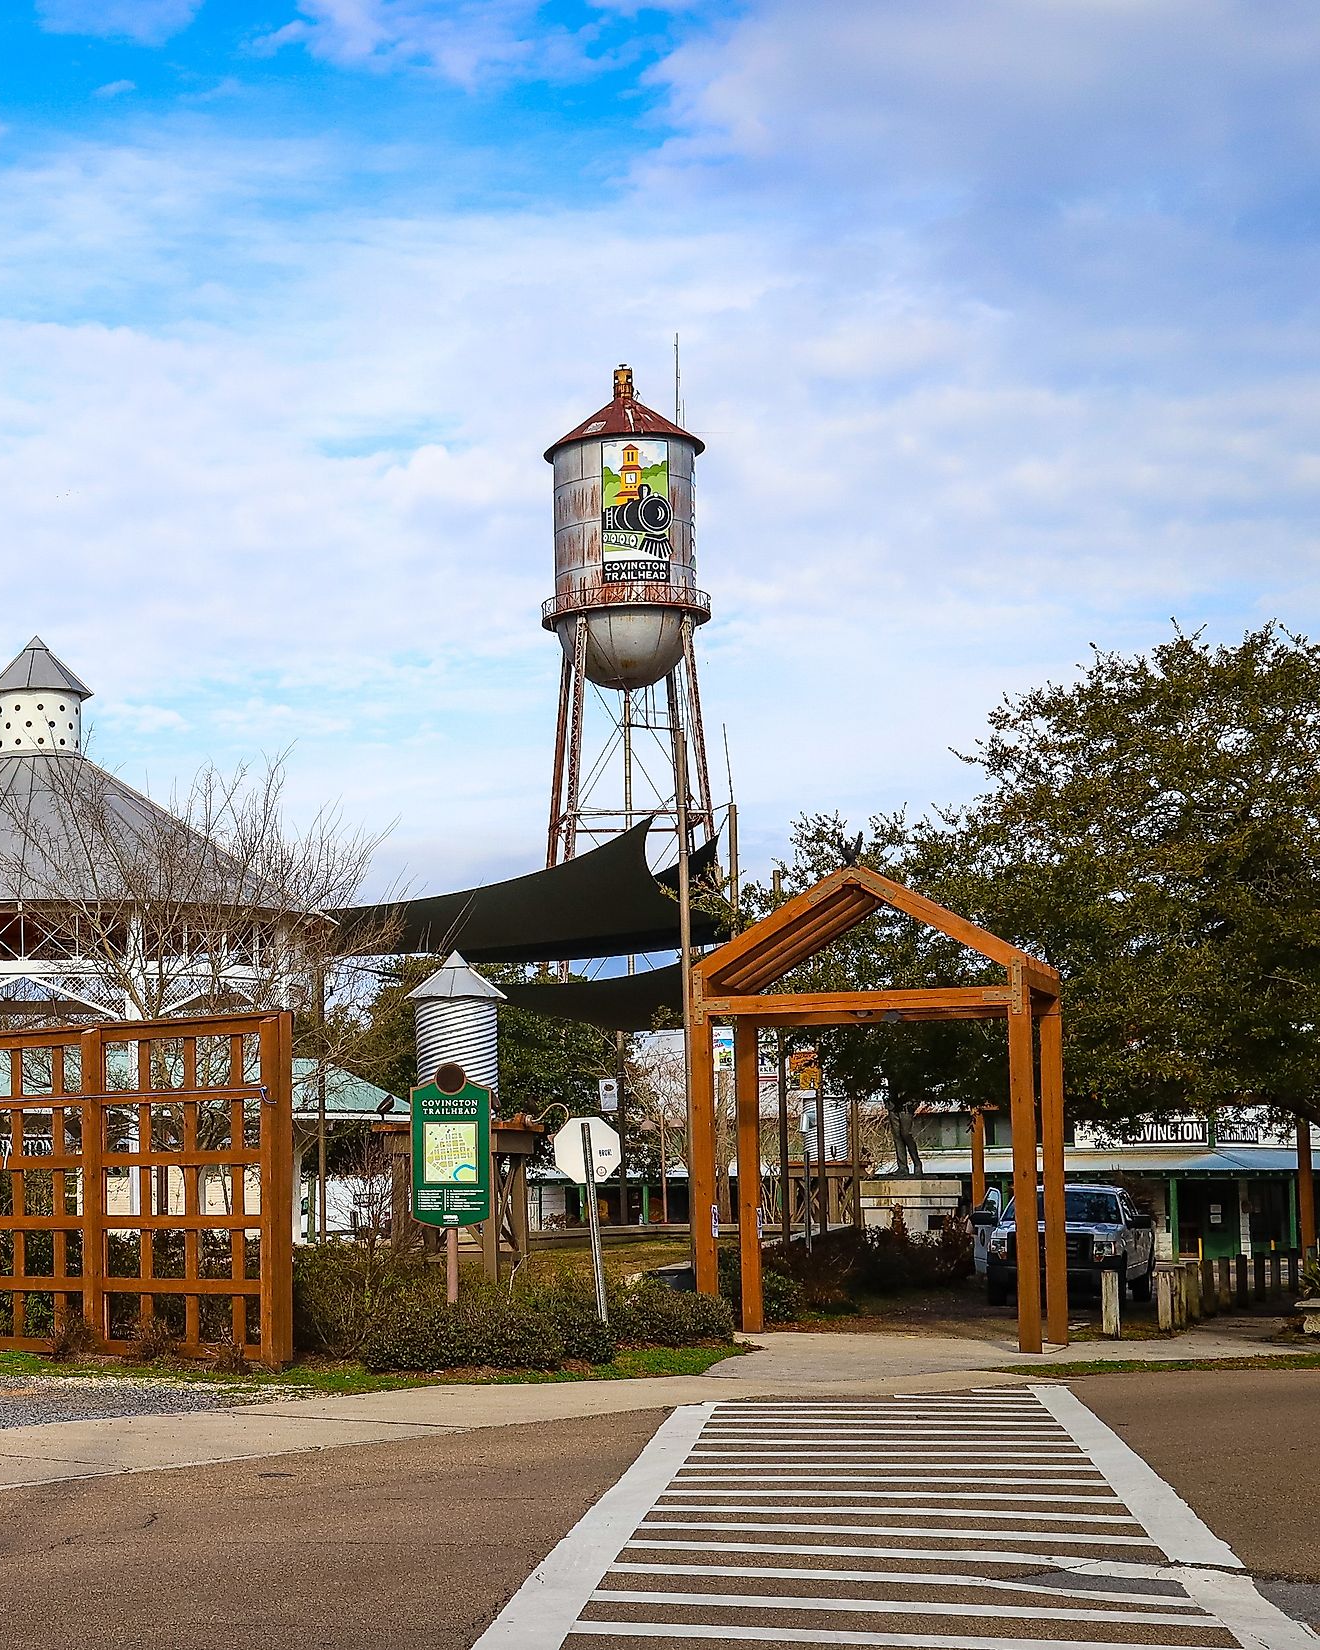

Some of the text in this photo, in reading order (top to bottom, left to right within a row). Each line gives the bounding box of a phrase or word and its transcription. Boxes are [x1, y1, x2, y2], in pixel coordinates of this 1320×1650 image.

[604, 561, 666, 571] COVINGTON
[604, 571, 667, 581] TRAILHEAD
[421, 1099, 478, 1107] COVINGTON
[423, 1107, 477, 1115] TRAILHEAD
